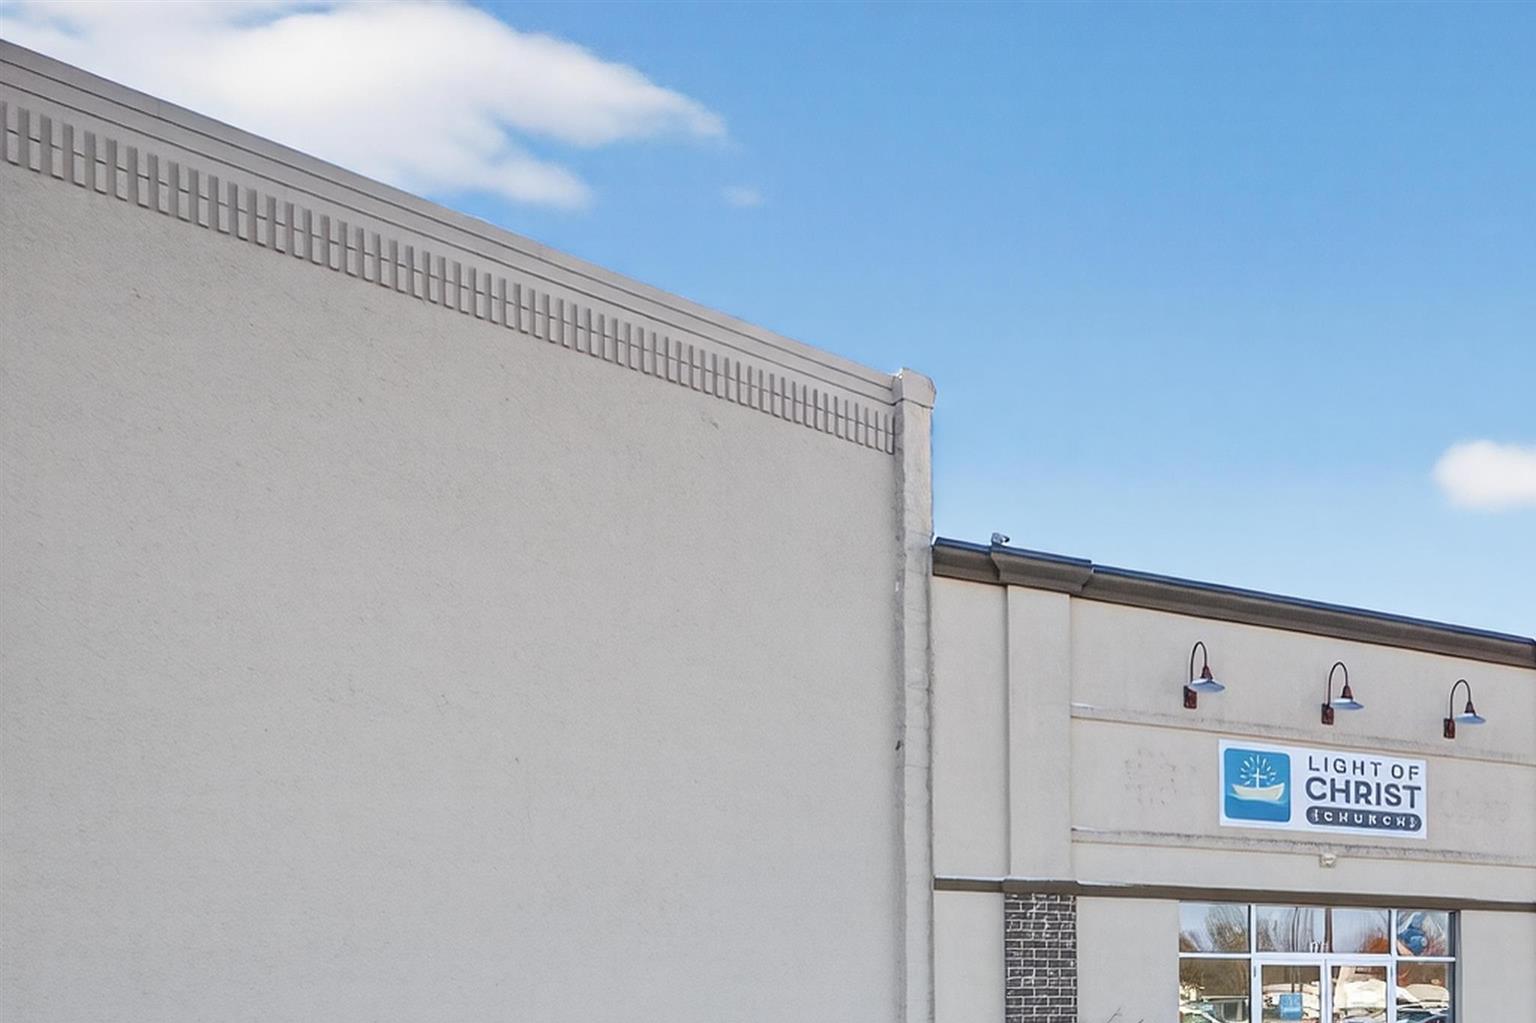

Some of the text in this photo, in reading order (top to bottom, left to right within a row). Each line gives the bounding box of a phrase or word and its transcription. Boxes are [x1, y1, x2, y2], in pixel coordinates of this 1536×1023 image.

[1308, 755, 1420, 781] LIGHT OF
[1305, 776, 1422, 809] CHRIST
[1323, 811, 1405, 827] CHURCH
